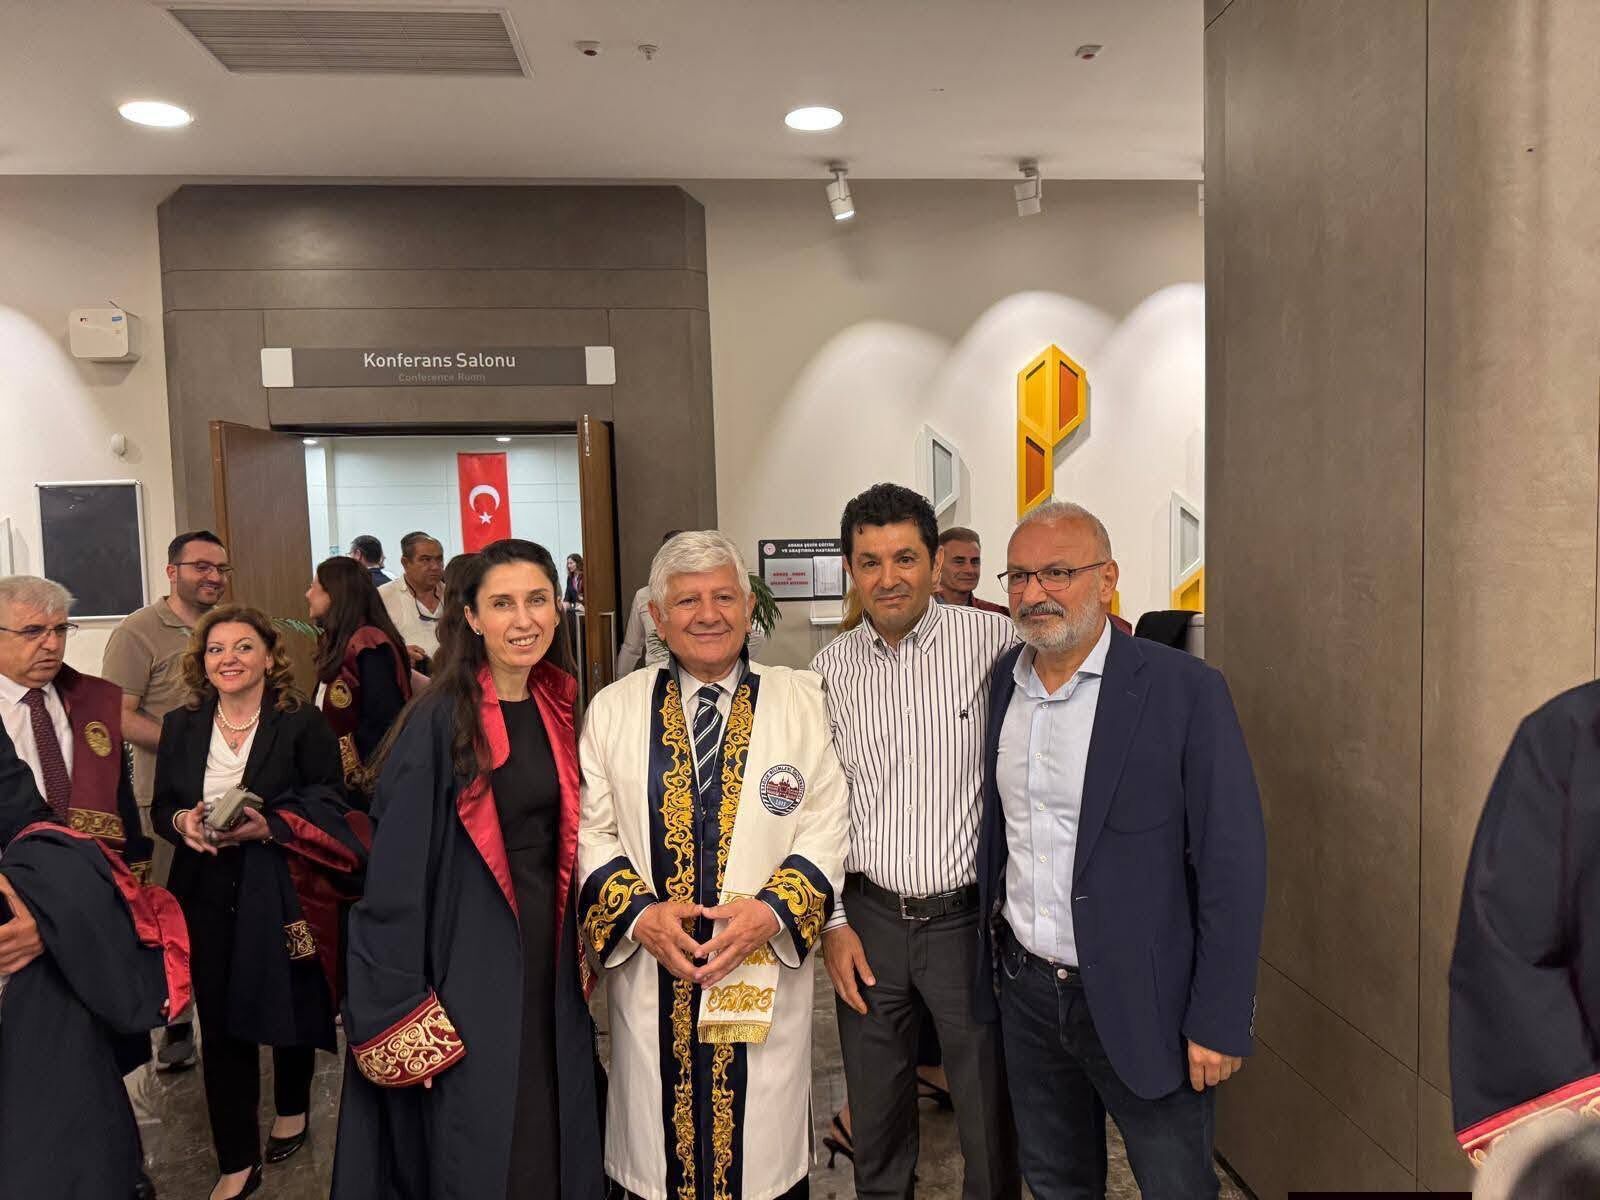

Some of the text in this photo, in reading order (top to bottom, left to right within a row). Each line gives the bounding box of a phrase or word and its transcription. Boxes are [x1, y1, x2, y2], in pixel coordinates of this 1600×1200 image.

[363, 352, 516, 368] Konferans Salonu
[398, 373, 486, 382] Conference Room
